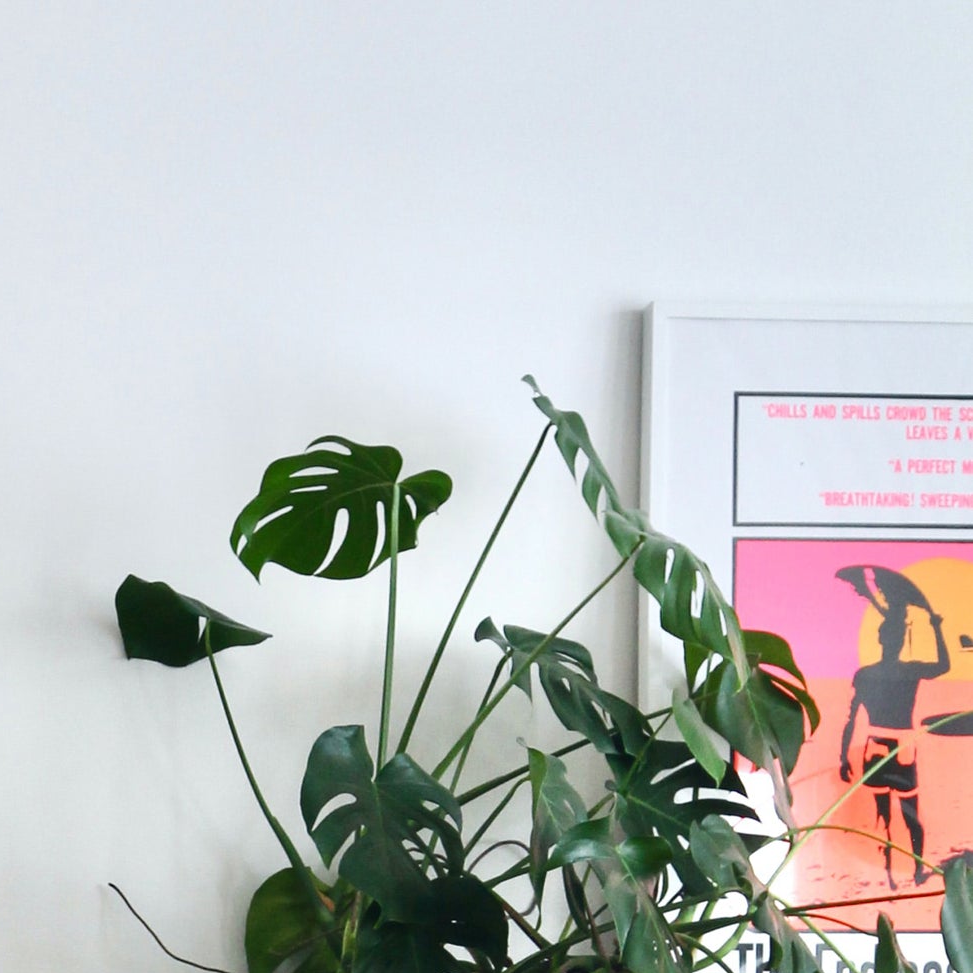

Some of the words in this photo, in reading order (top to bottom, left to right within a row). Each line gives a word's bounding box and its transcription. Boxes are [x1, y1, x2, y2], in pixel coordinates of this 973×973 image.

[813, 404, 836, 419] AND
[842, 405, 880, 420] SPILLS
[886, 406, 926, 421] CROWD
[933, 407, 952, 421] THE
[905, 425, 948, 440] LEAVES
[954, 426, 961, 440] A
[907, 459, 955, 474] PERFECT
